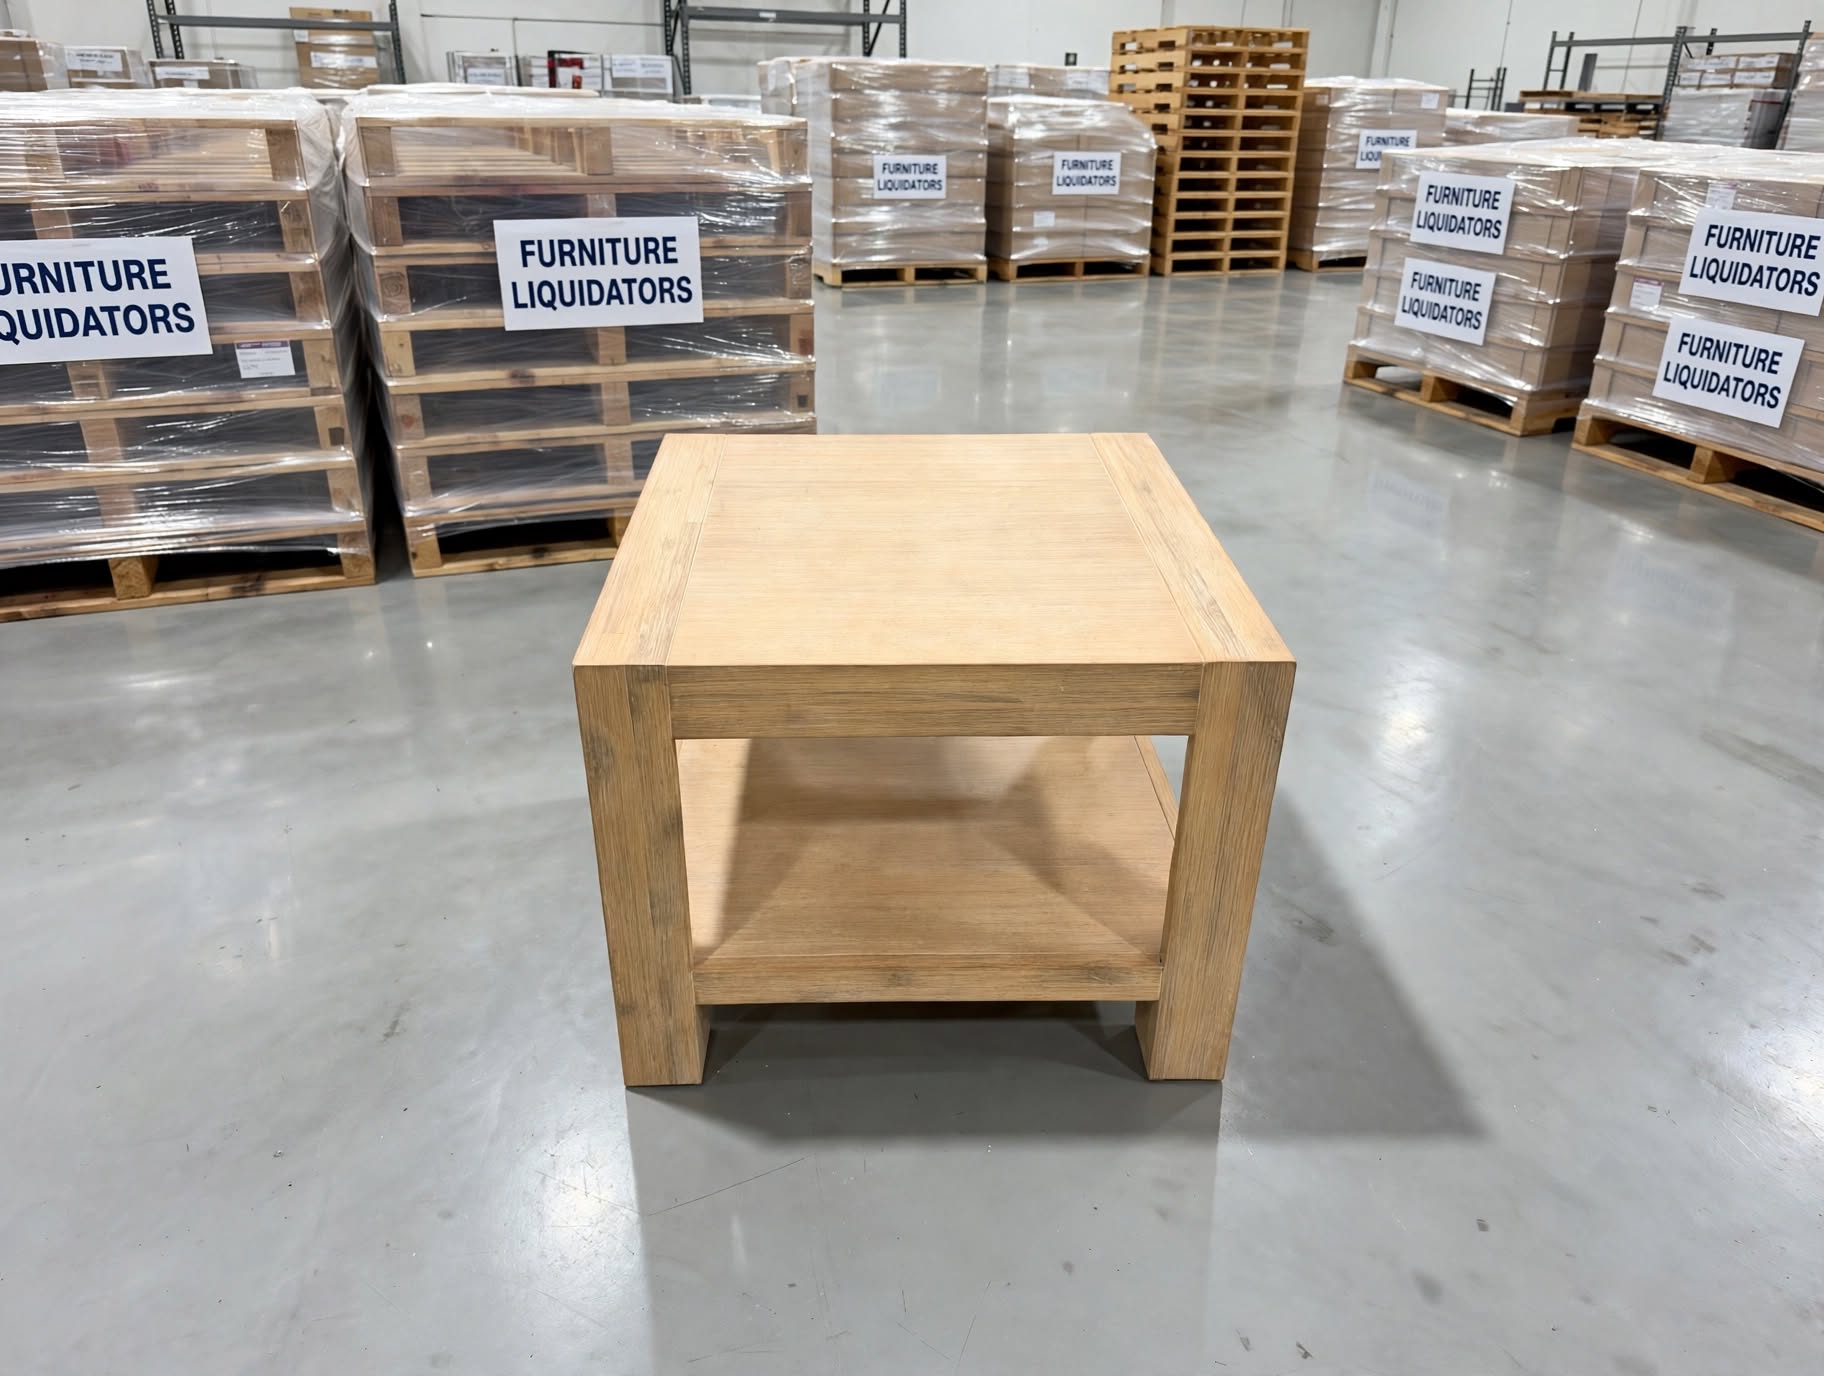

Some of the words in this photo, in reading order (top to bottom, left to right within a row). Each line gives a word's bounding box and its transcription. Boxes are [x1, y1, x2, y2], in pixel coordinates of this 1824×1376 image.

[1366, 136, 1410, 148] FURNITURE
[881, 162, 939, 175] FURNITURE
[1061, 159, 1114, 171] FURNITURE
[877, 179, 943, 192] LIQUIDATORS
[1056, 175, 1117, 187] LIQUIDATORS
[1425, 184, 1502, 211] FURNITURE
[1416, 209, 1503, 240] LIQUIDATORS
[518, 236, 679, 268] FURNITURE
[1704, 224, 1821, 261] FURNITURE
[1410, 271, 1482, 302] FURNITURE
[1689, 255, 1821, 297] LIQUIDATORS
[511, 275, 693, 311] LIQUIDATORS
[1401, 296, 1483, 330] LIQUIDATORS
[1677, 332, 1783, 375] FURNITURE
[1663, 361, 1782, 409] LIQUIDATORS
